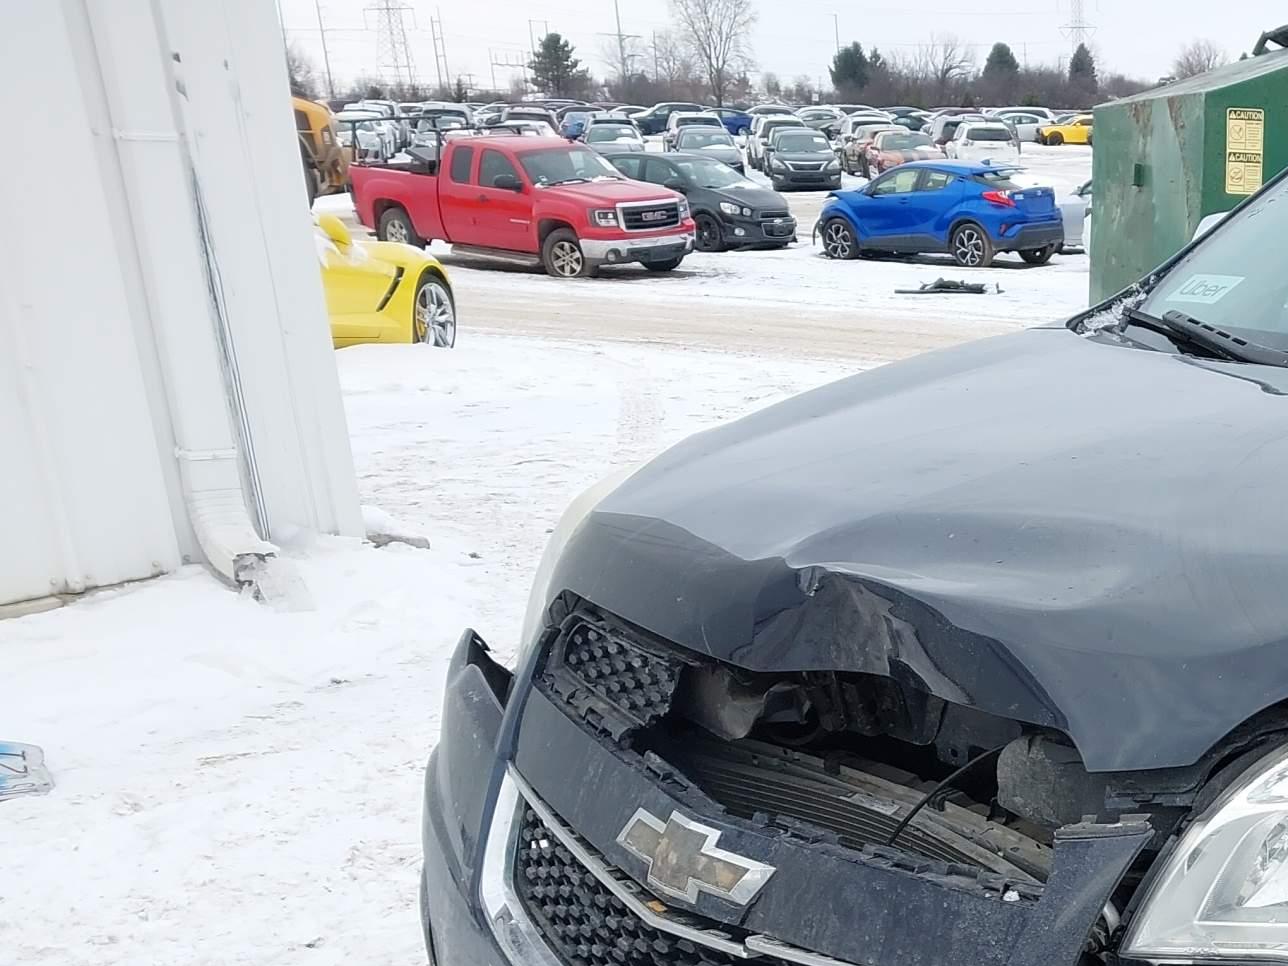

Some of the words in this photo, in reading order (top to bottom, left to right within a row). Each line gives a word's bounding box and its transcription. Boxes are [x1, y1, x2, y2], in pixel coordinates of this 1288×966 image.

[1236, 110, 1263, 120] CAUTION
[1235, 153, 1262, 163] CAUTION
[641, 210, 668, 221] GMC
[1179, 279, 1228, 297] Uber
